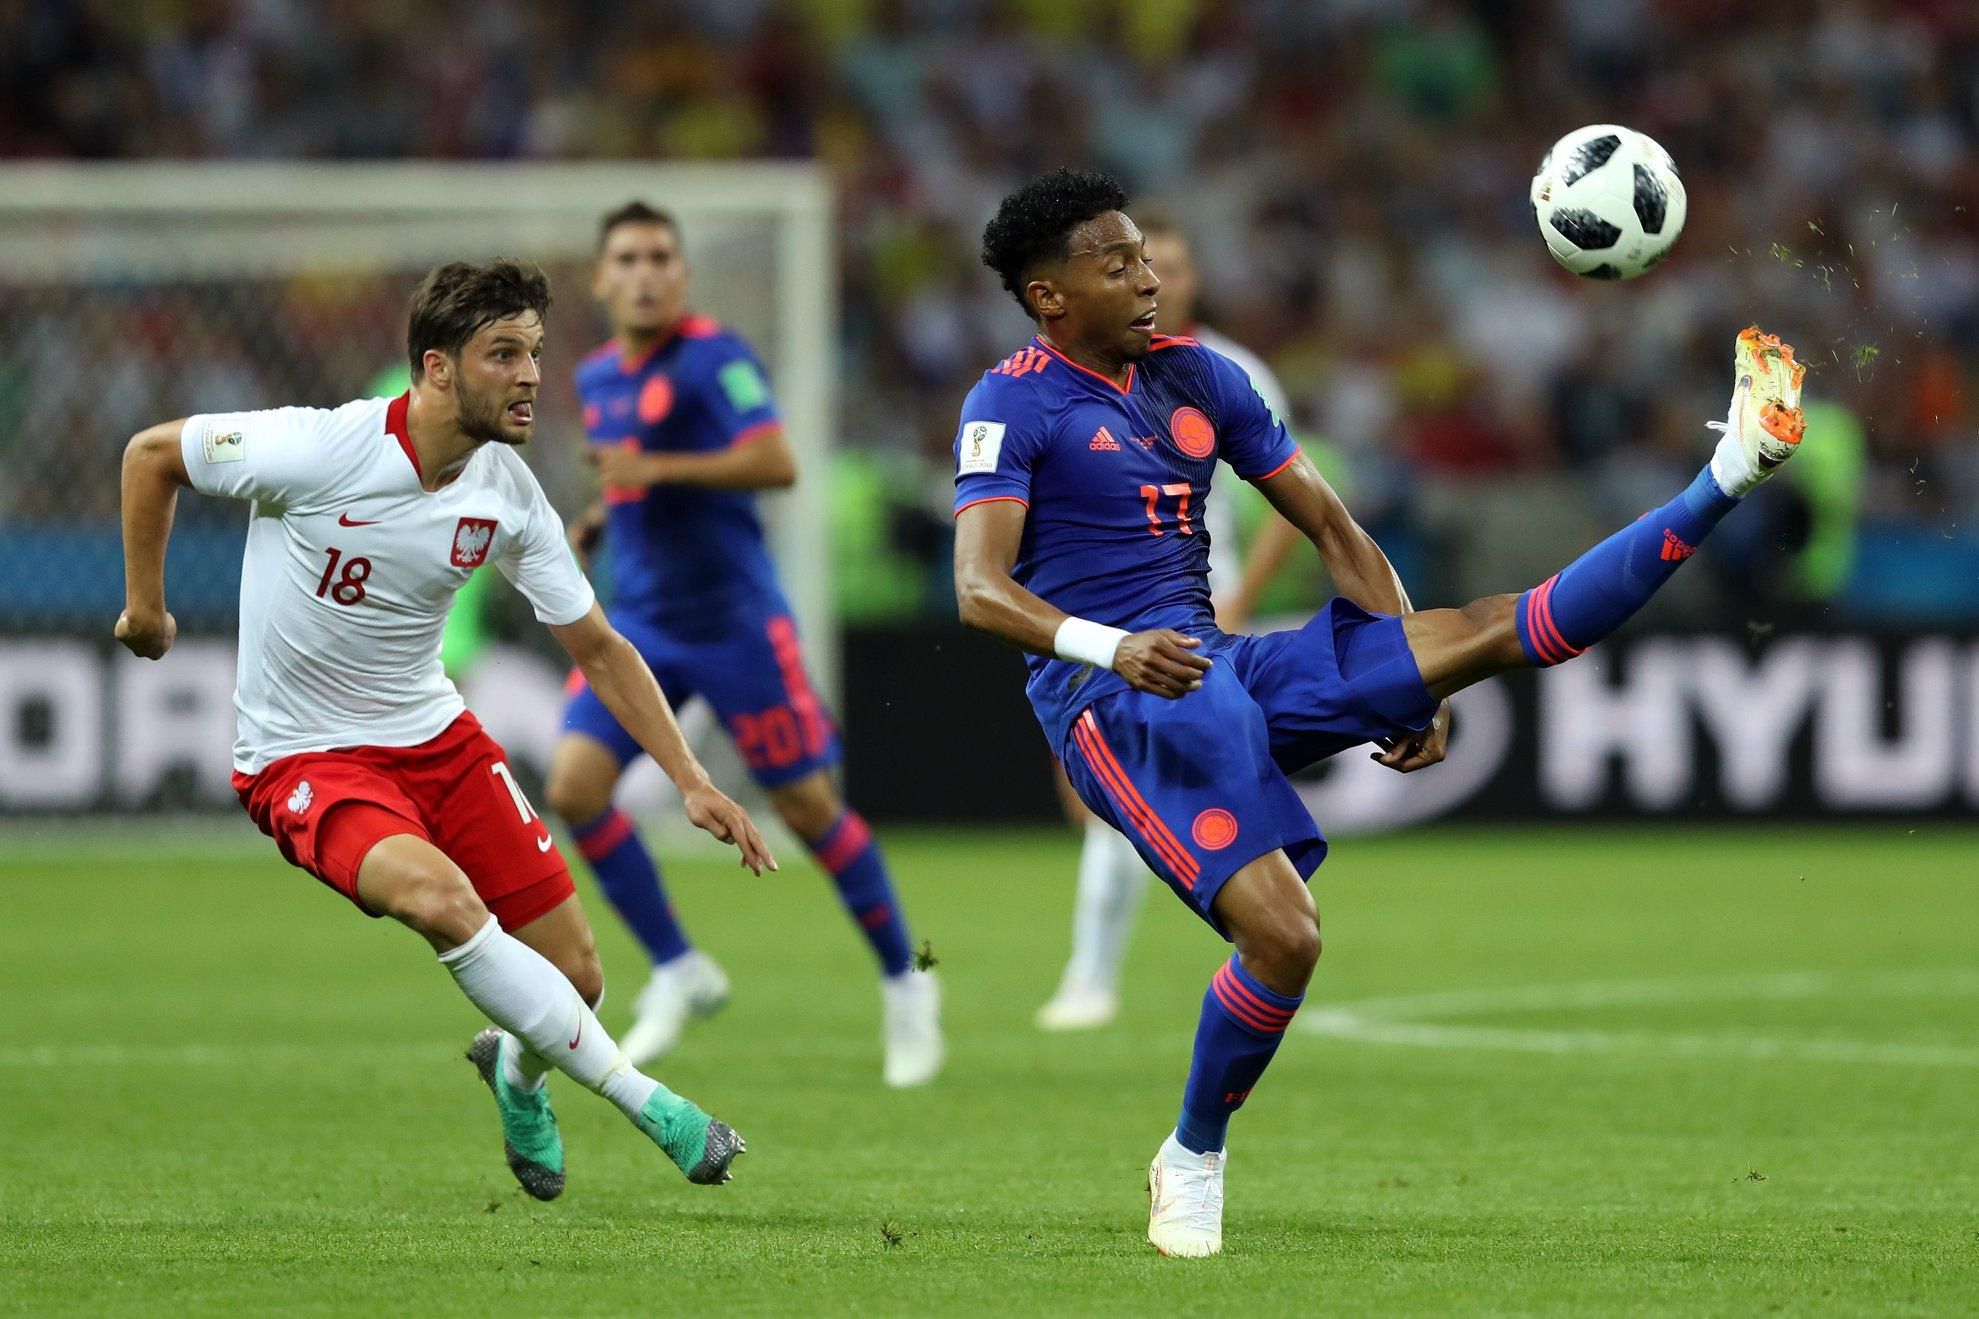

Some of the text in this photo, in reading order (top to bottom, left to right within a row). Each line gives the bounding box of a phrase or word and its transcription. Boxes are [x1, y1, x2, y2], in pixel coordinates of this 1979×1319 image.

[1088, 441, 1121, 451] adidas
[1140, 482, 1193, 537] 17
[315, 546, 372, 606] 18
[1541, 634, 1979, 808] HYU
[491, 761, 540, 825] 1
